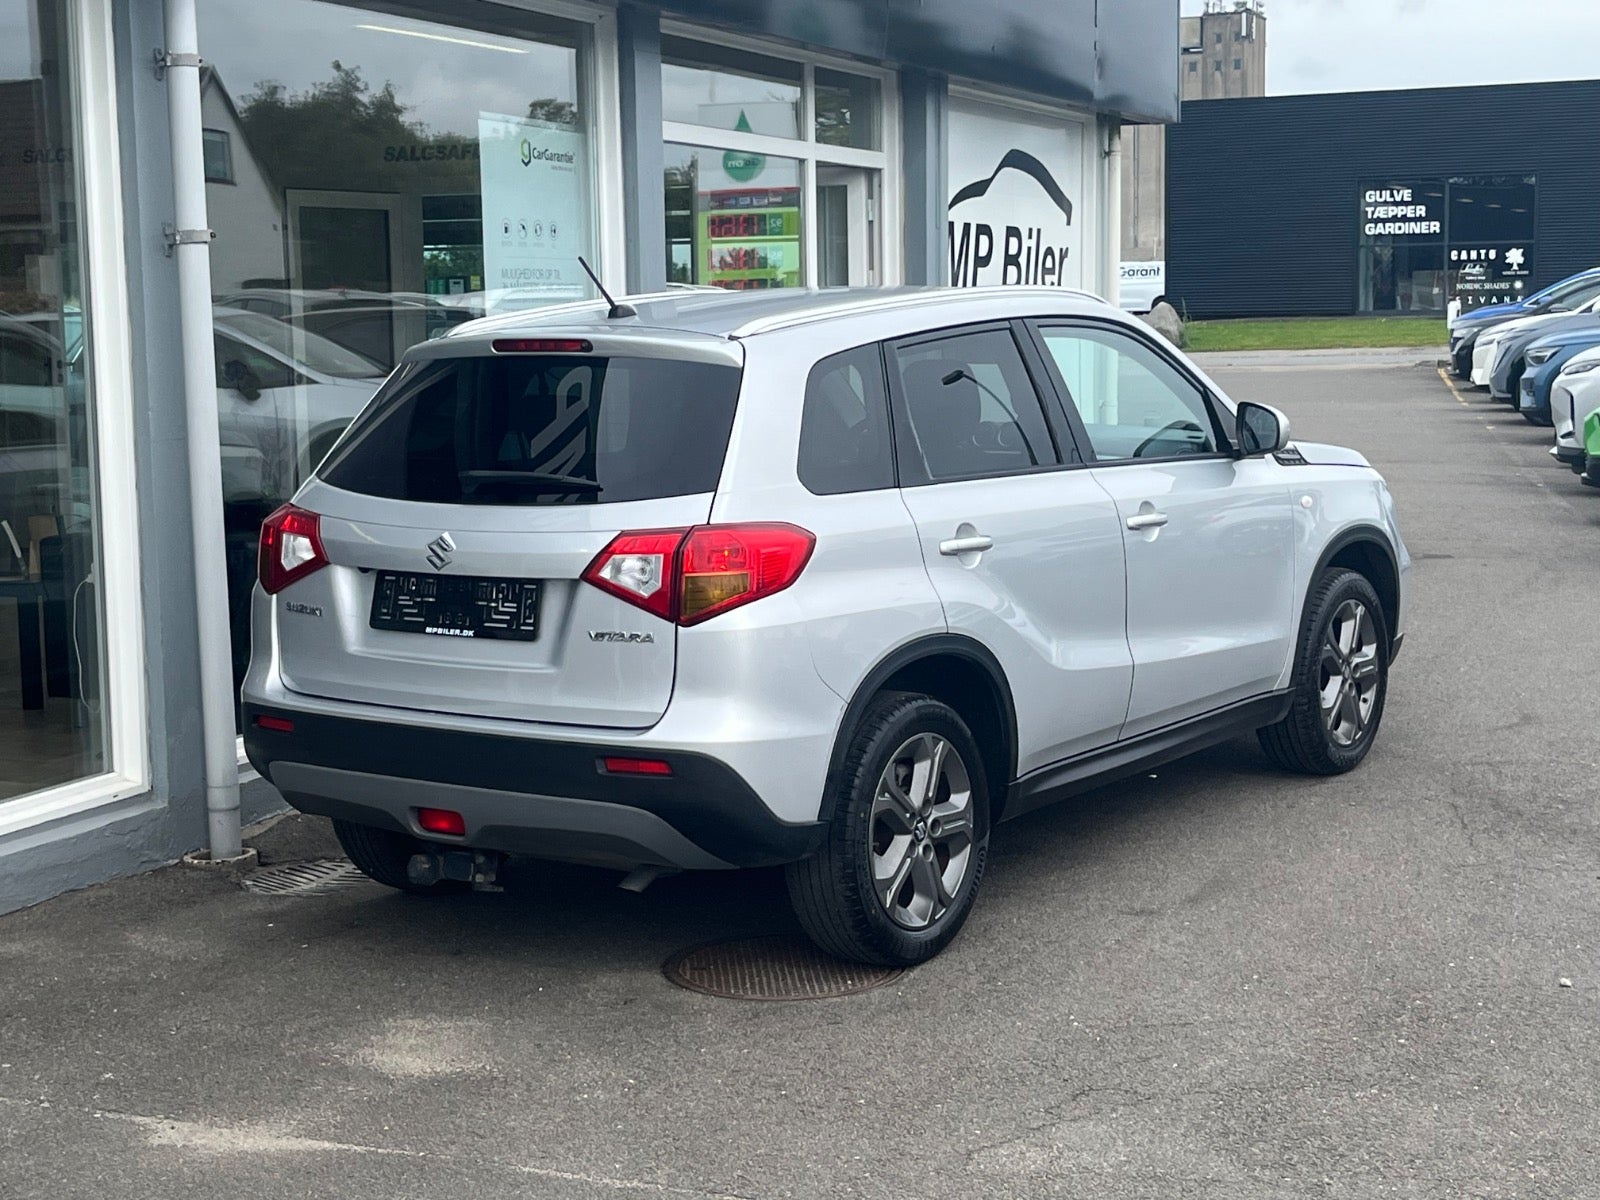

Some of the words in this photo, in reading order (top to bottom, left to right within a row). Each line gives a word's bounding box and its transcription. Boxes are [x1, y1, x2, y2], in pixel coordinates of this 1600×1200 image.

[1365, 189, 1412, 203] GULVE
[1365, 205, 1426, 219] TÆPPER
[1365, 221, 1440, 235] GARDINER
[948, 221, 994, 287] MP
[1002, 225, 1069, 287] Biler
[1456, 282, 1482, 291] NORDIC
[286, 601, 323, 617] SUZUKI
[425, 626, 475, 637] MPBILER.DK
[587, 630, 655, 644] VITARA
